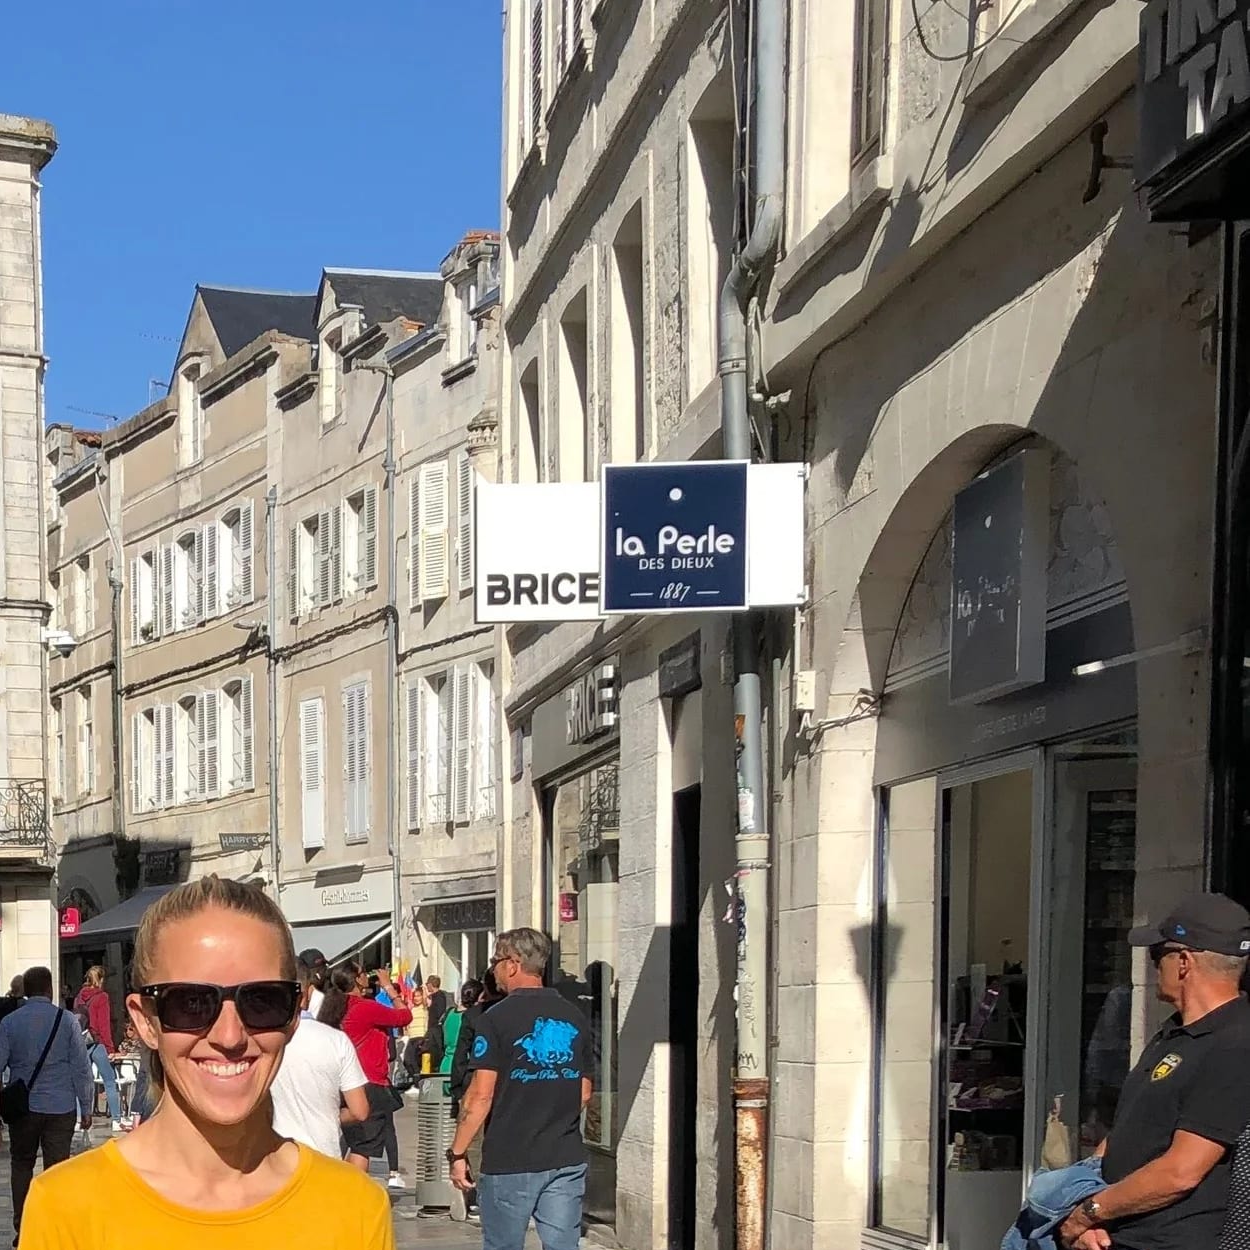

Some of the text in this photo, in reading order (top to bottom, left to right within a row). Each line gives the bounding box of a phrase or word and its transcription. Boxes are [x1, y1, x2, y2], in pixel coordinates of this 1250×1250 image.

[615, 525, 735, 556] la Perle
[639, 556, 714, 570] DES DIEUX
[487, 572, 600, 605] BRICE
[659, 582, 691, 602] 1887
